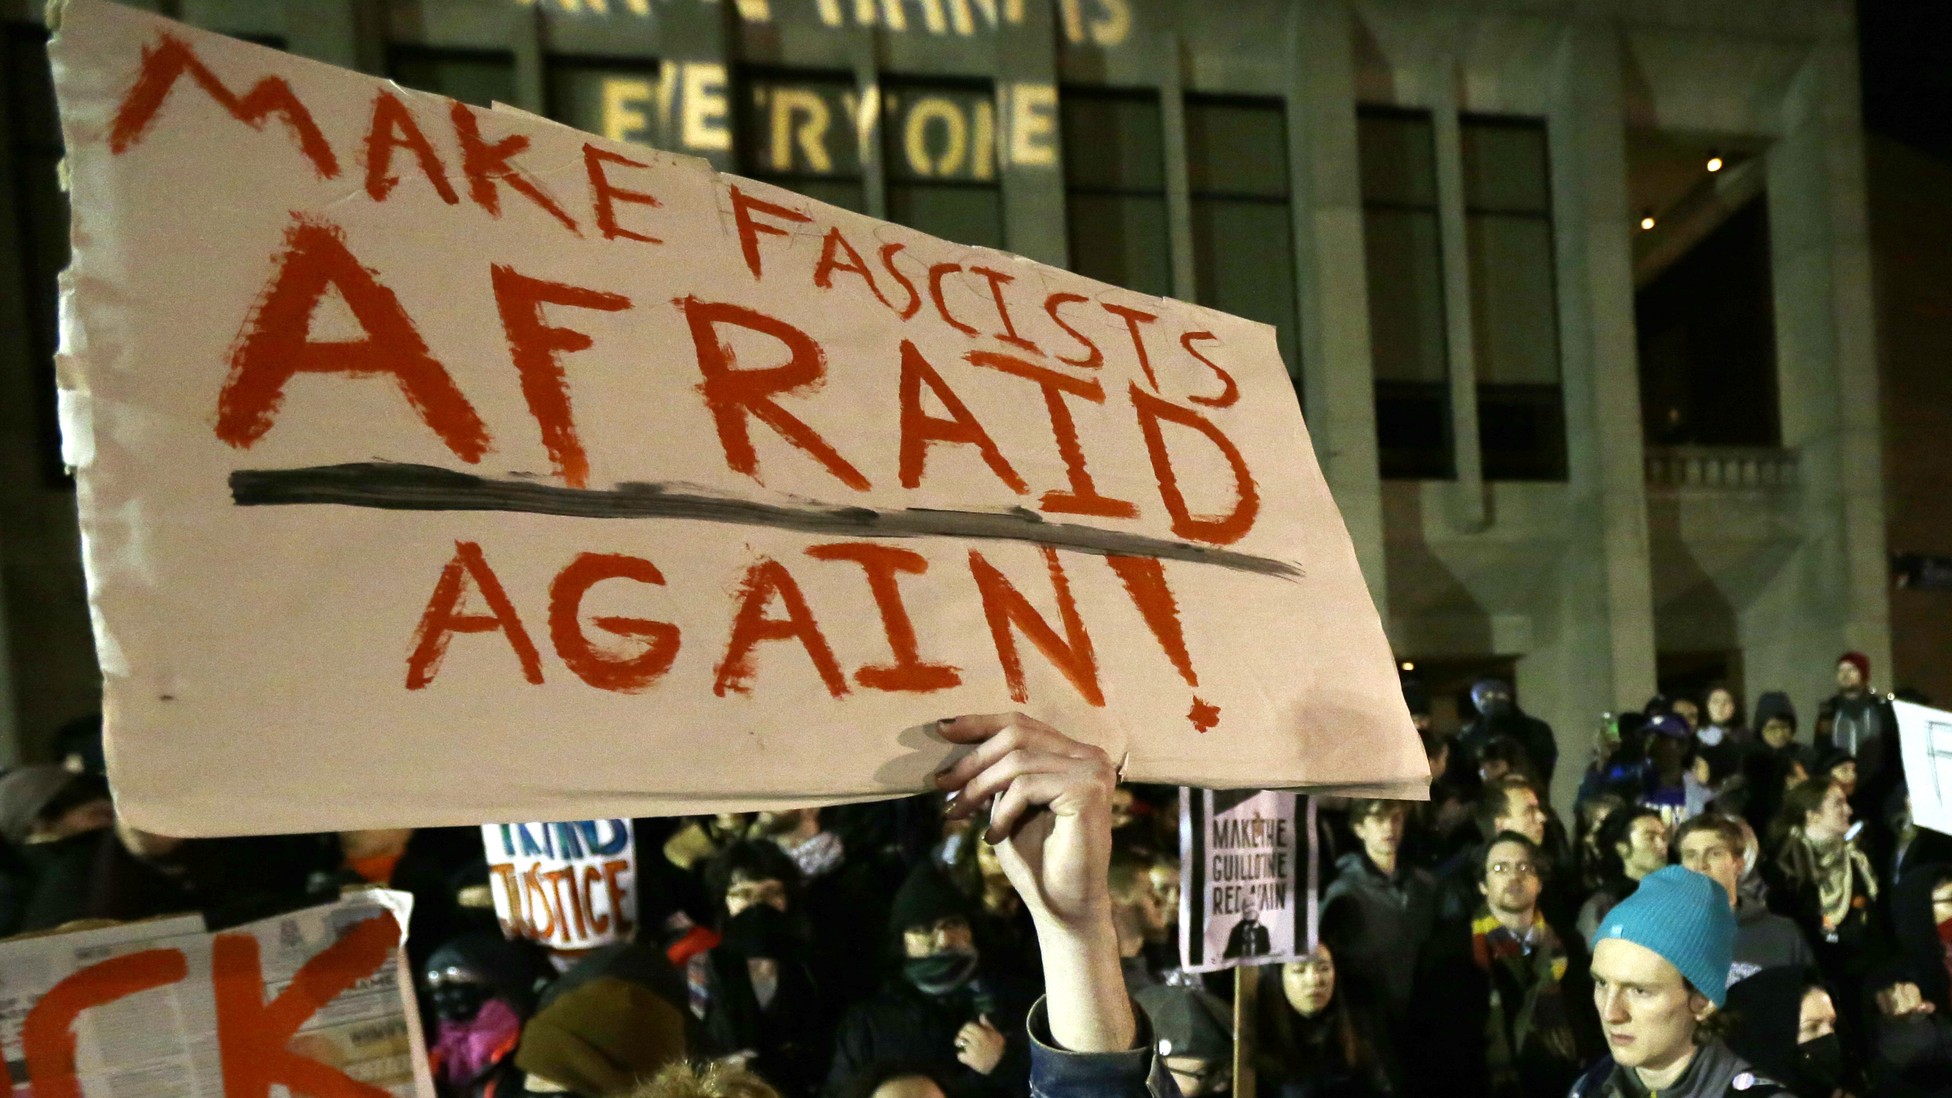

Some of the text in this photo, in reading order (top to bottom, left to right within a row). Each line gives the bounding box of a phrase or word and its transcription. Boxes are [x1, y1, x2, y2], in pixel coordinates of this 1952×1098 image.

[603, 60, 1058, 181] EVERYONE
[110, 32, 1241, 409] MAKE FASCISTS
[212, 211, 1262, 545] AFRAID
[405, 540, 1222, 732] AGAIN!
[490, 861, 633, 943] JUSTICE
[1213, 818, 1287, 849] MAKE THE
[1249, 883, 1286, 912] AIN
[0, 906, 402, 1098] CK
